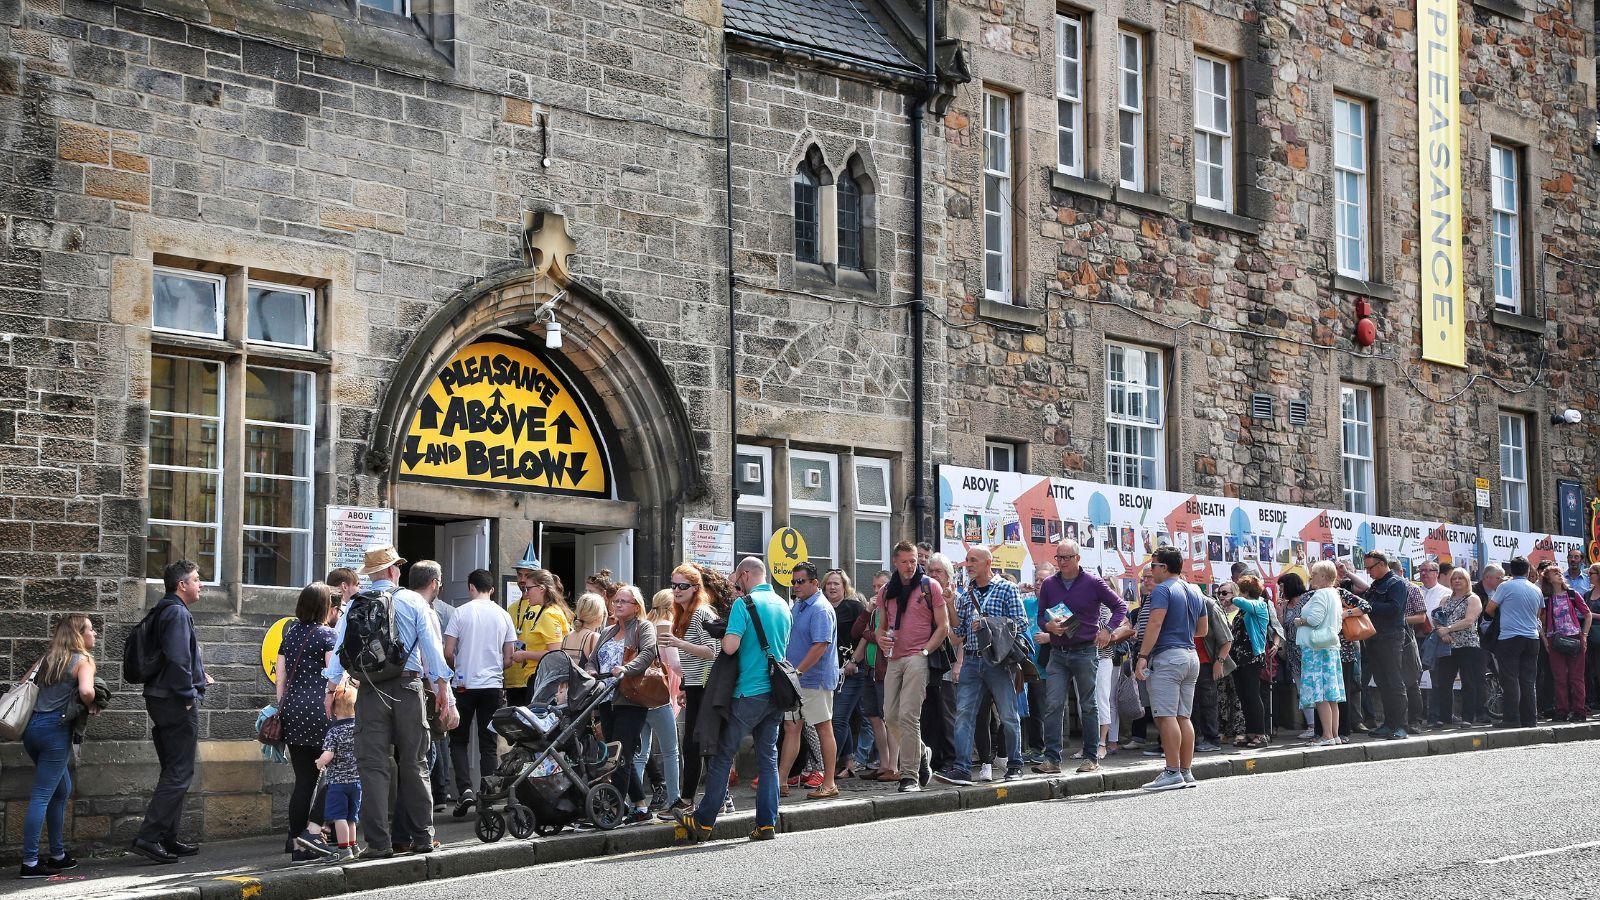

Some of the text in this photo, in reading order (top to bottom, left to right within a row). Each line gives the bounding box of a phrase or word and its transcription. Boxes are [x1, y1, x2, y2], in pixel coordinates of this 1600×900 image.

[1427, 7, 1453, 326] PLEASANCE
[437, 353, 560, 407] PLEASANCE
[440, 396, 547, 445] ABOVE
[424, 440, 567, 488] AND BELOW
[962, 475, 999, 493] ABOVE
[1046, 484, 1075, 501] ATTIC
[1119, 493, 1153, 510] BELOW
[1186, 500, 1226, 517] BENEATH
[347, 511, 373, 520] ABOVE
[1258, 508, 1288, 524] BESIDE
[1319, 515, 1353, 531] BEYOND
[698, 523, 719, 531] BELOW
[1370, 522, 1420, 540] BUNKER ONE
[781, 527, 798, 559] Q
[1428, 527, 1477, 545] BUNKER TWO
[1493, 535, 1520, 549] CELLAR
[1534, 538, 1581, 553] CABARET BAR
[773, 566, 793, 575] Below
